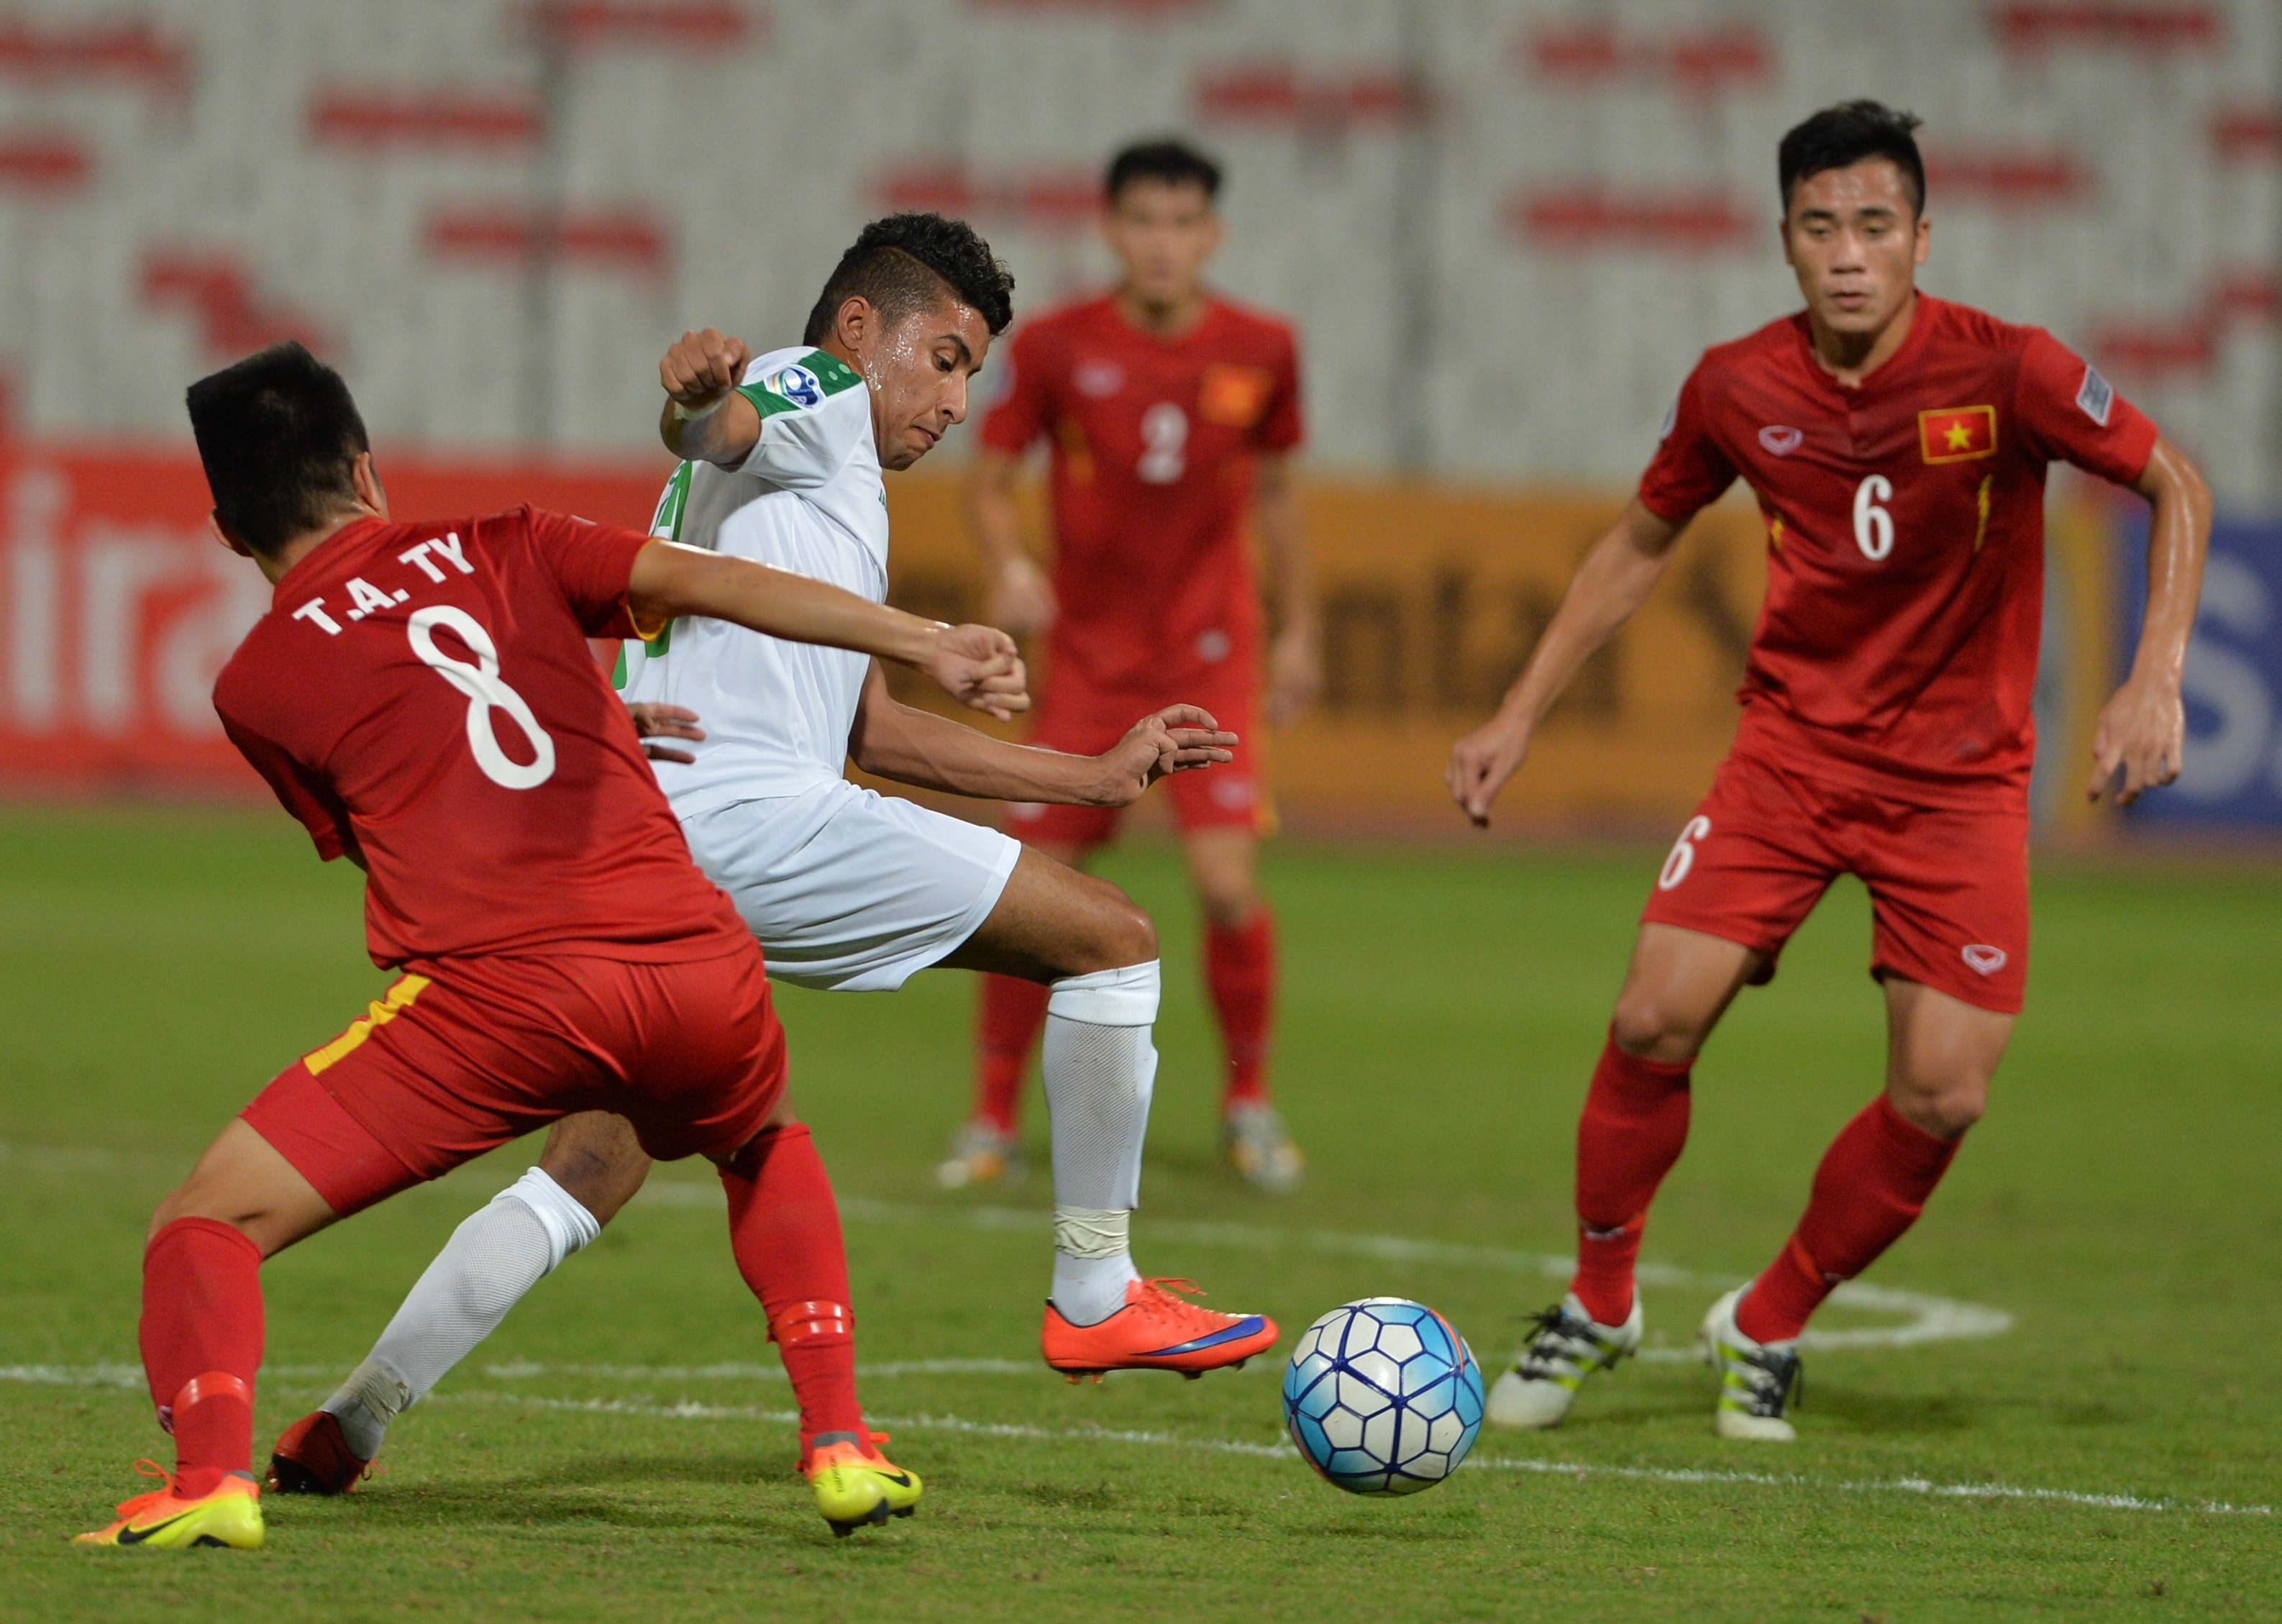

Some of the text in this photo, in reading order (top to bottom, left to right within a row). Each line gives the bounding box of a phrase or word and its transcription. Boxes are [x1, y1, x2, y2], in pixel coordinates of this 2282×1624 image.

[1853, 474, 1894, 561] 6
[291, 532, 475, 637] T.A. TY
[406, 604, 556, 790] 8
[1658, 814, 1711, 891] 6
